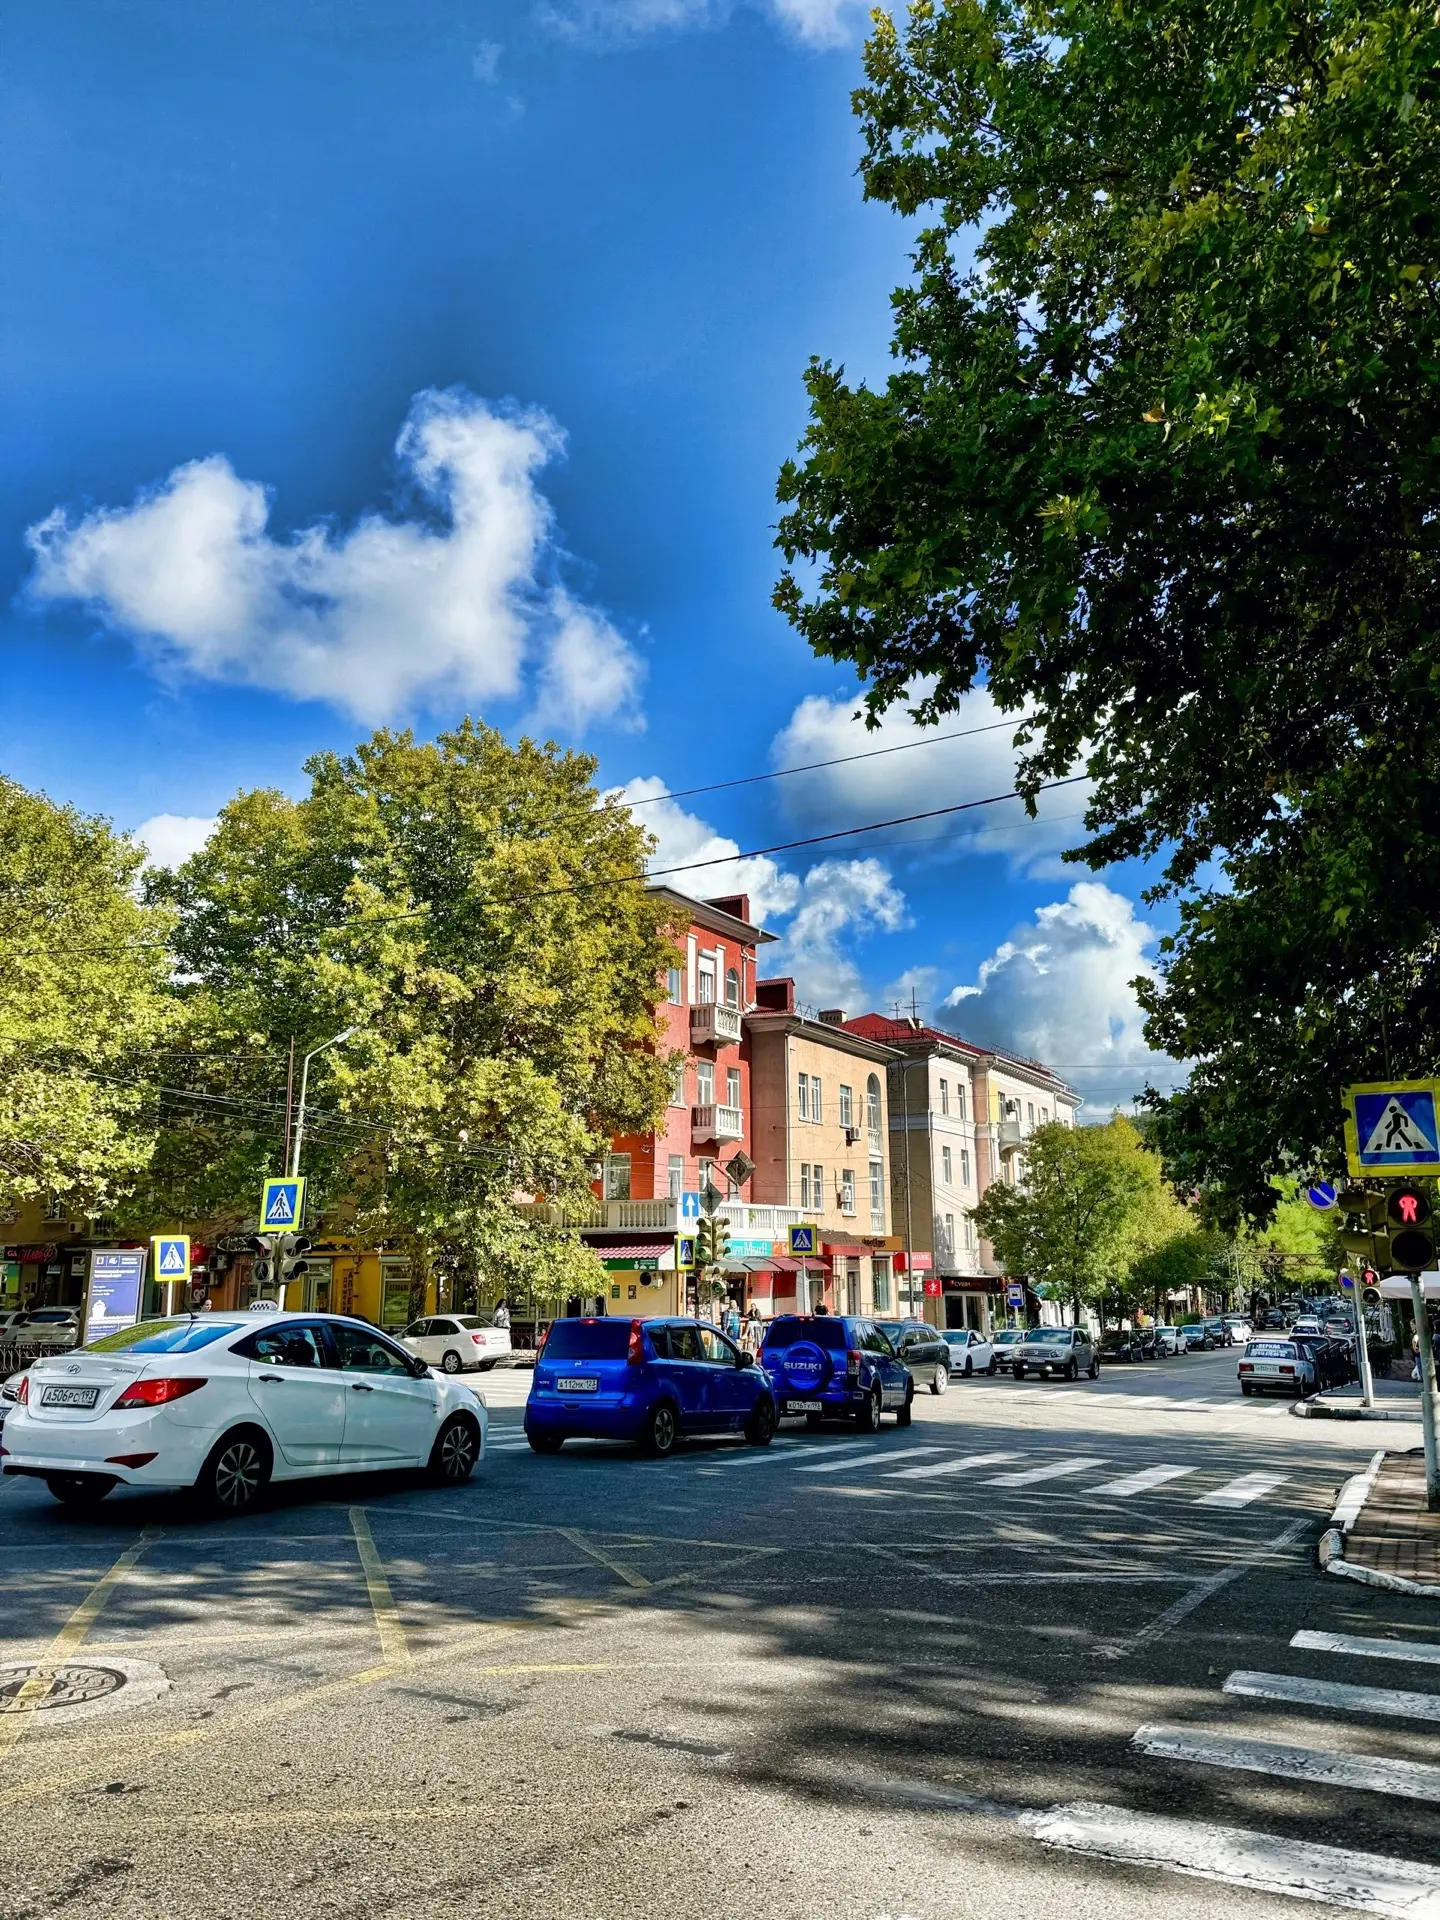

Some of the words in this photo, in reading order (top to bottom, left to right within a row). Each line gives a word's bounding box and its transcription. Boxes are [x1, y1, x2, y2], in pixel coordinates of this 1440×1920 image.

[784, 1361, 822, 1370] SUZUKI
[45, 1387, 79, 1403] А506РС
[80, 1389, 95, 1401] 193
